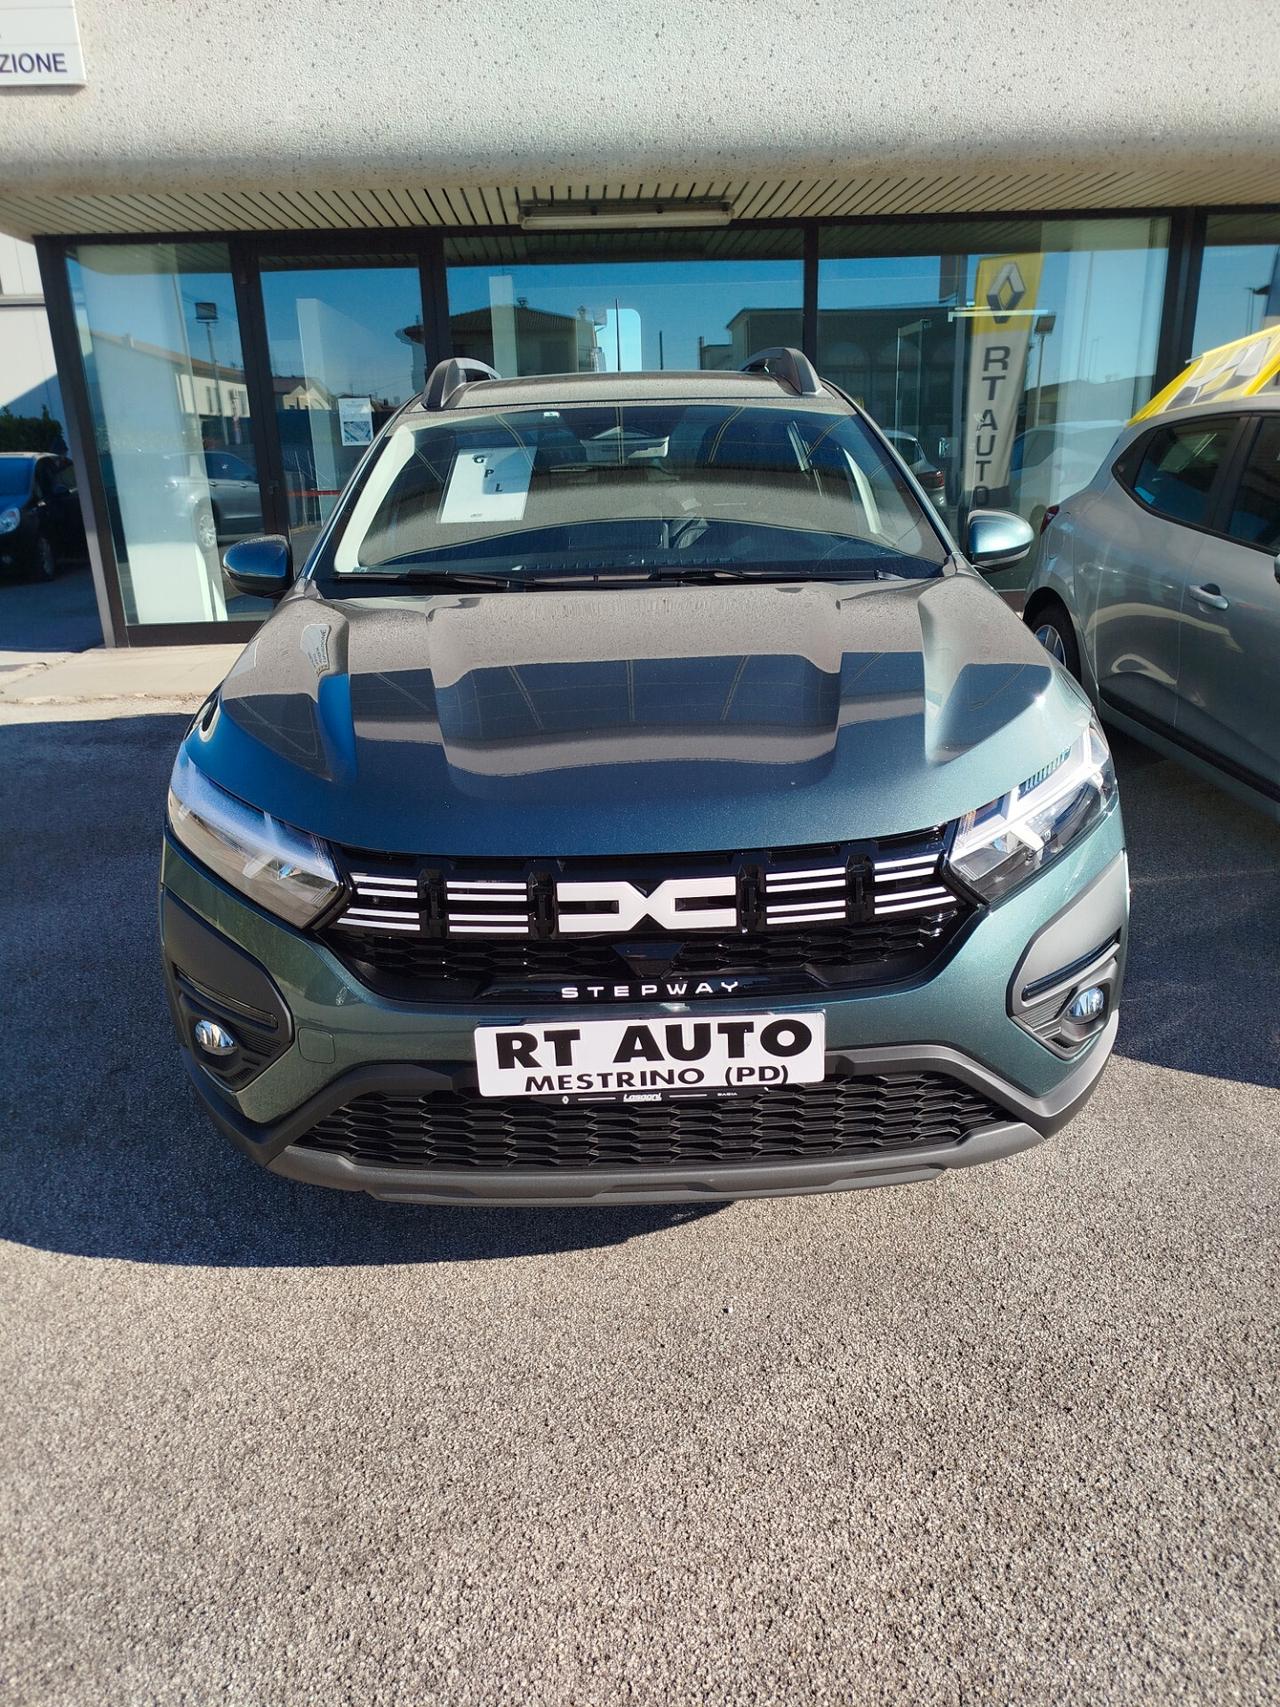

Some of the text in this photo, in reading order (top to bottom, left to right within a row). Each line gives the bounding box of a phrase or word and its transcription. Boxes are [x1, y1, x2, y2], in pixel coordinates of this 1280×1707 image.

[561, 981, 738, 999] STEPWAY
[495, 1018, 813, 1070] RT AUTO
[525, 1064, 789, 1093] MESTRINO (PD)
